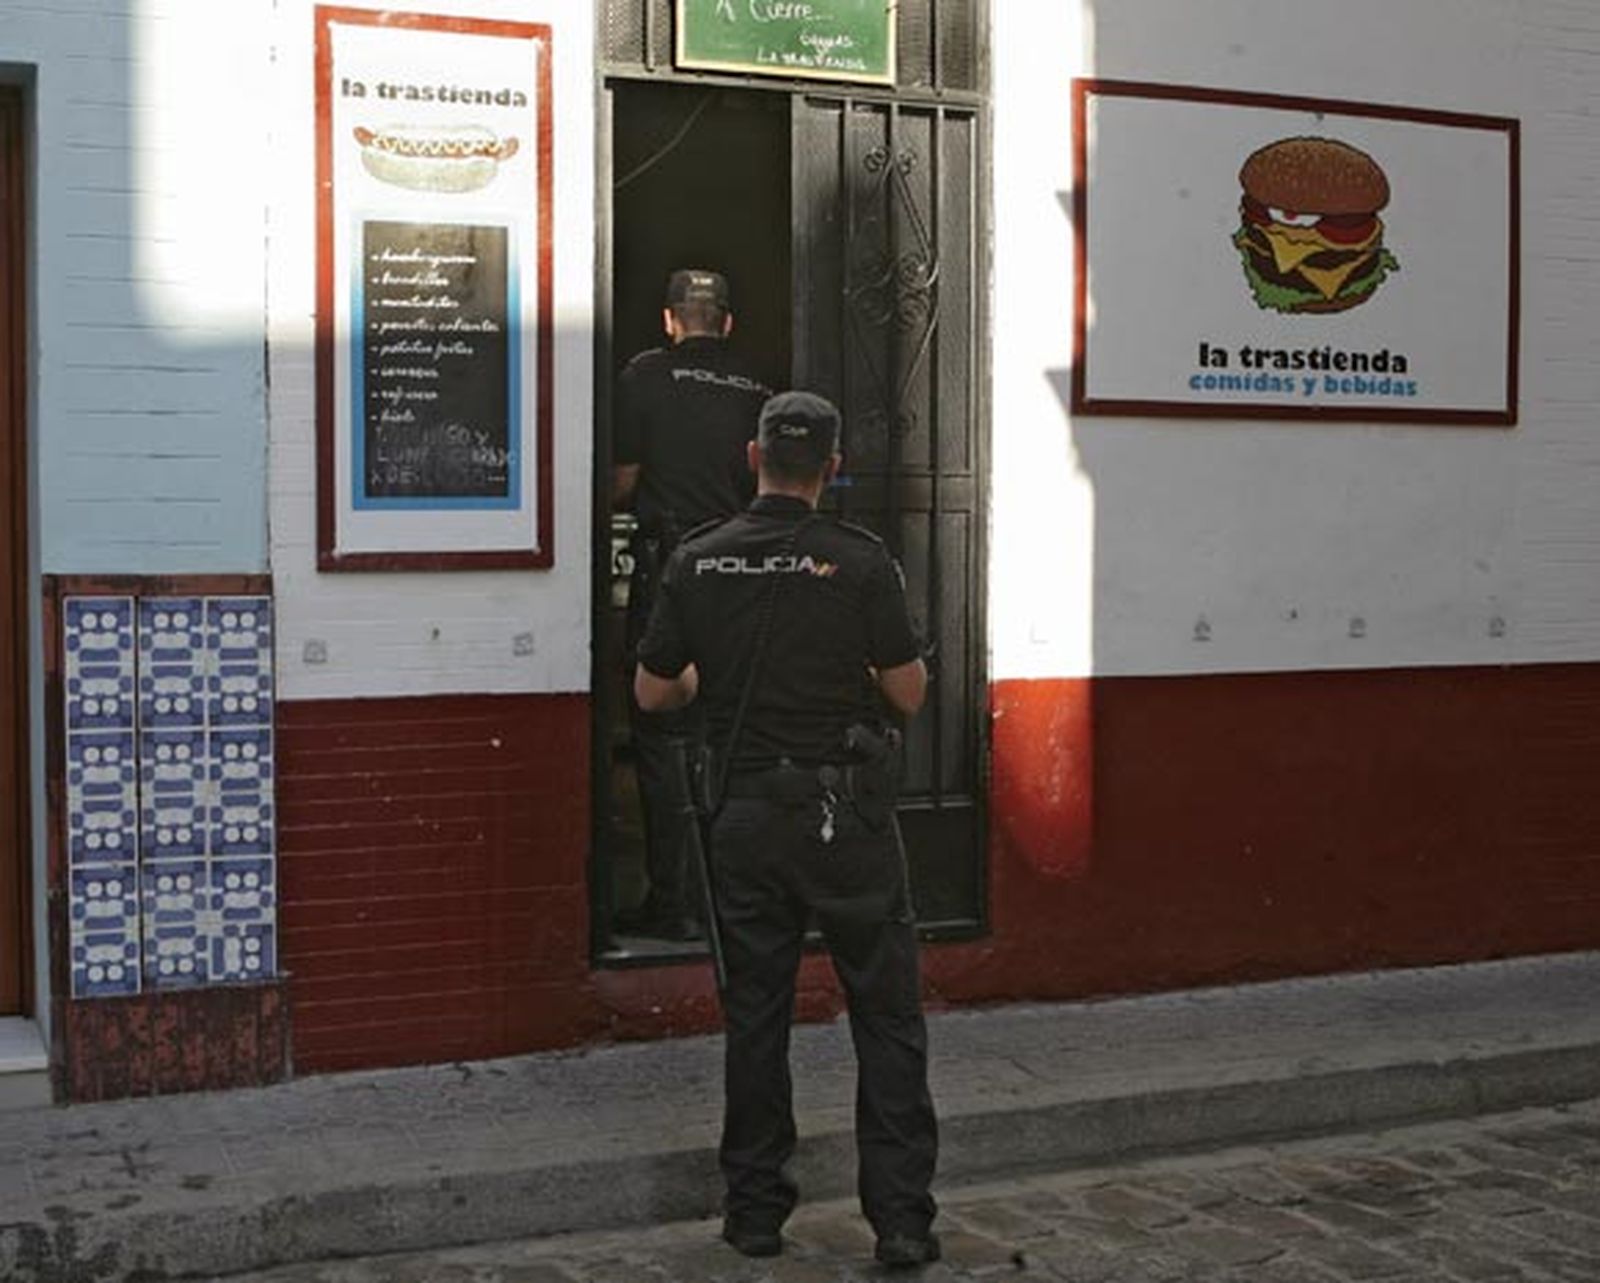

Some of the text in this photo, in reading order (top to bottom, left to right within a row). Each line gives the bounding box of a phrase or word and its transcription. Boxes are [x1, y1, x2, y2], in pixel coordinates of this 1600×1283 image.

[341, 78, 528, 107] la trastienda
[1199, 342, 1408, 374] la trastienda
[1189, 373, 1417, 397] comidas y bebidas
